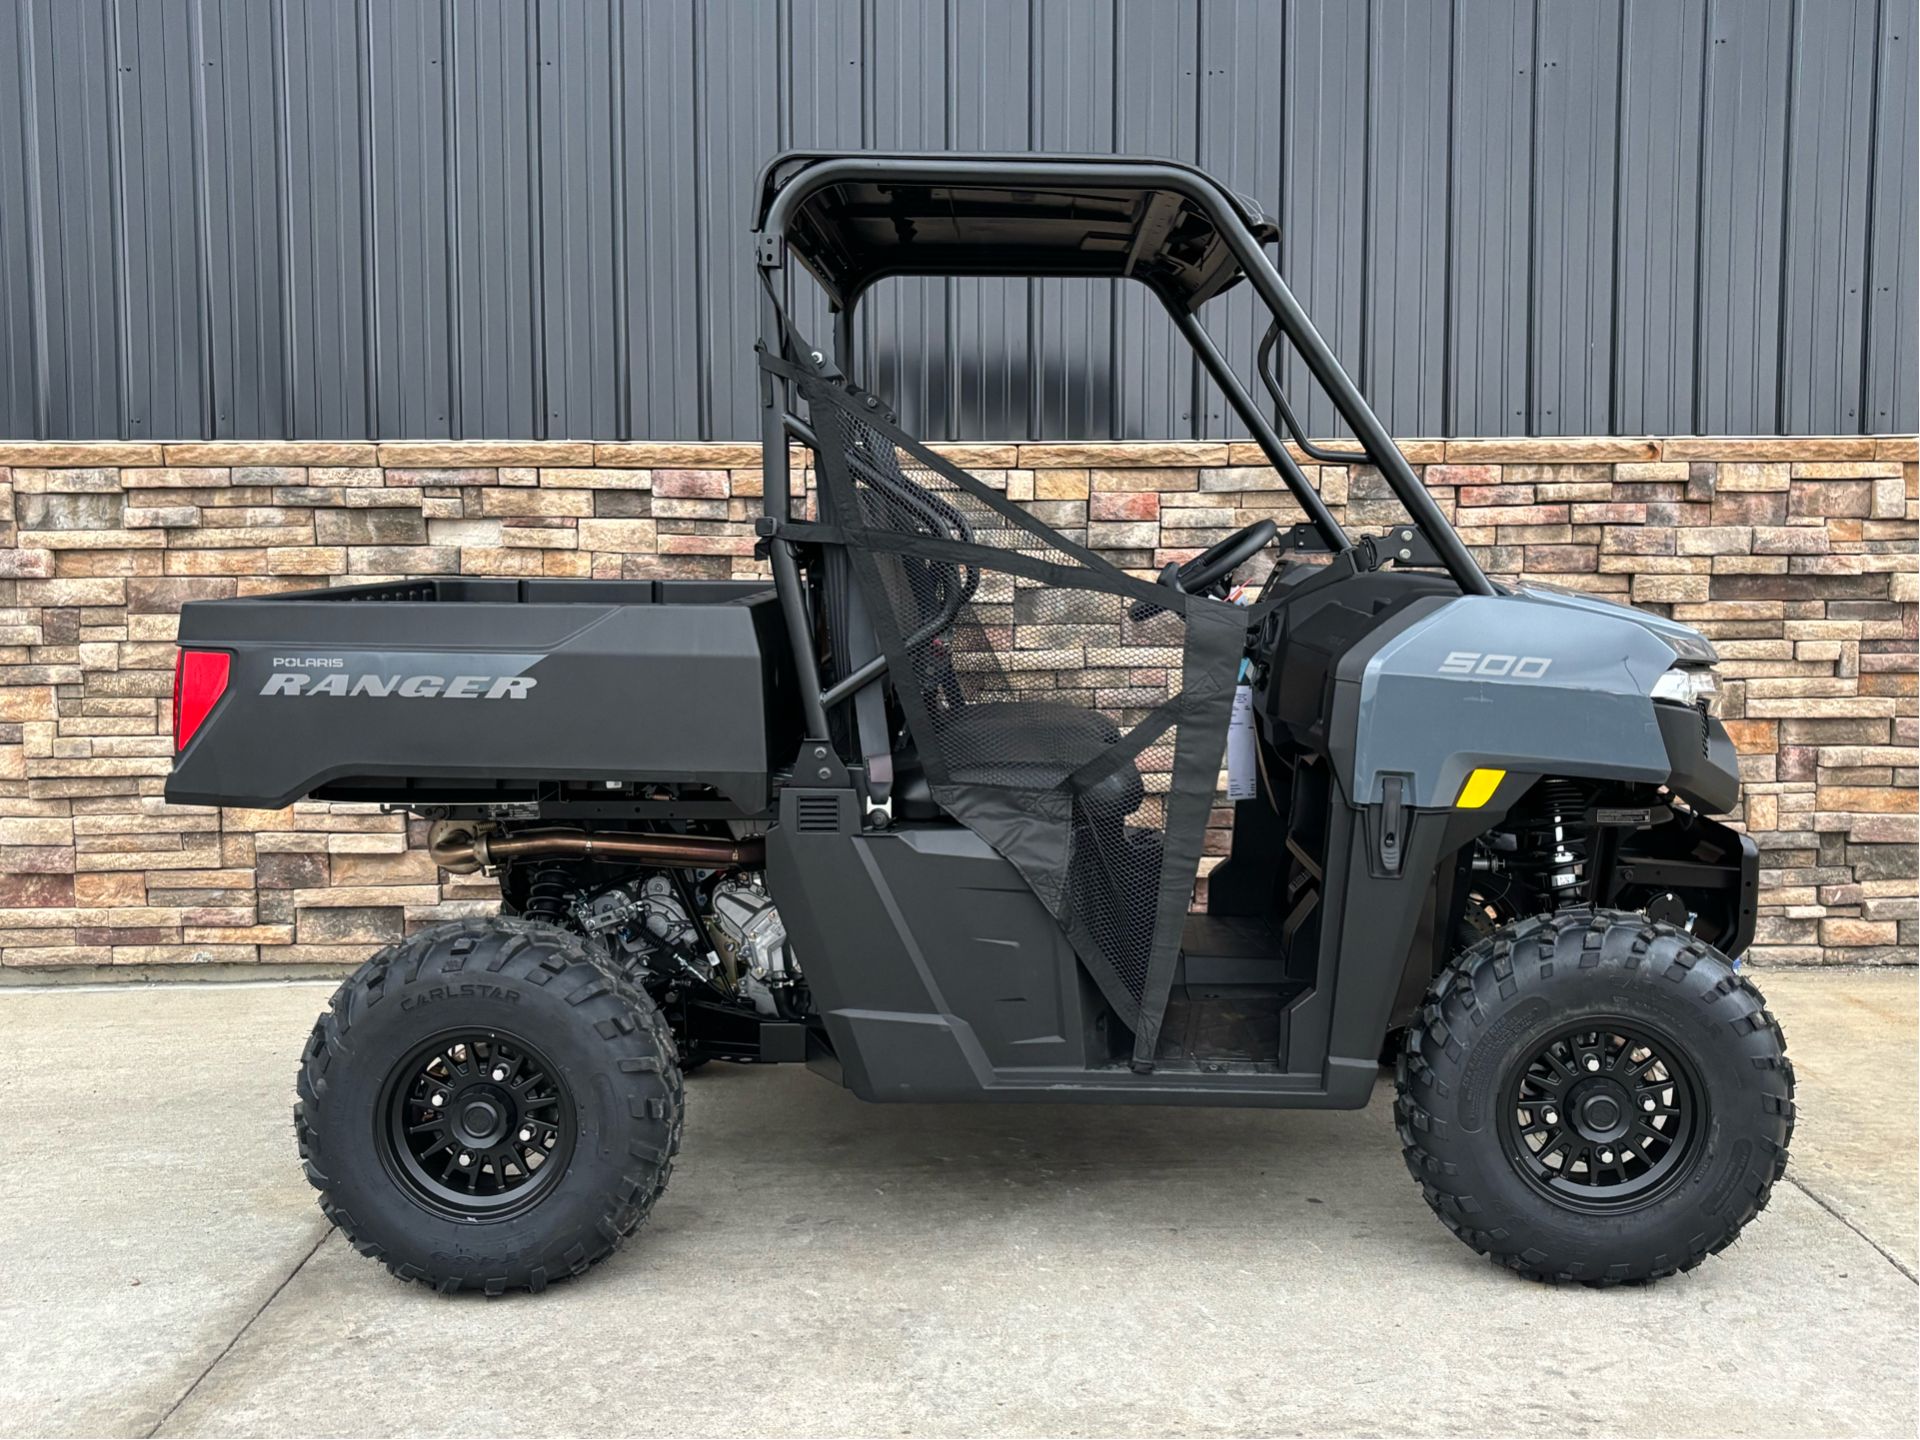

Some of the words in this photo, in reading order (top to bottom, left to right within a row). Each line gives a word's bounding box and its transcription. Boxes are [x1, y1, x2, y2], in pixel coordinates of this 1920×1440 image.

[273, 657, 344, 668] POLARIS
[1438, 651, 1553, 679] 500
[259, 673, 538, 700] RANGER
[400, 984, 520, 1012] CARLSTAR
